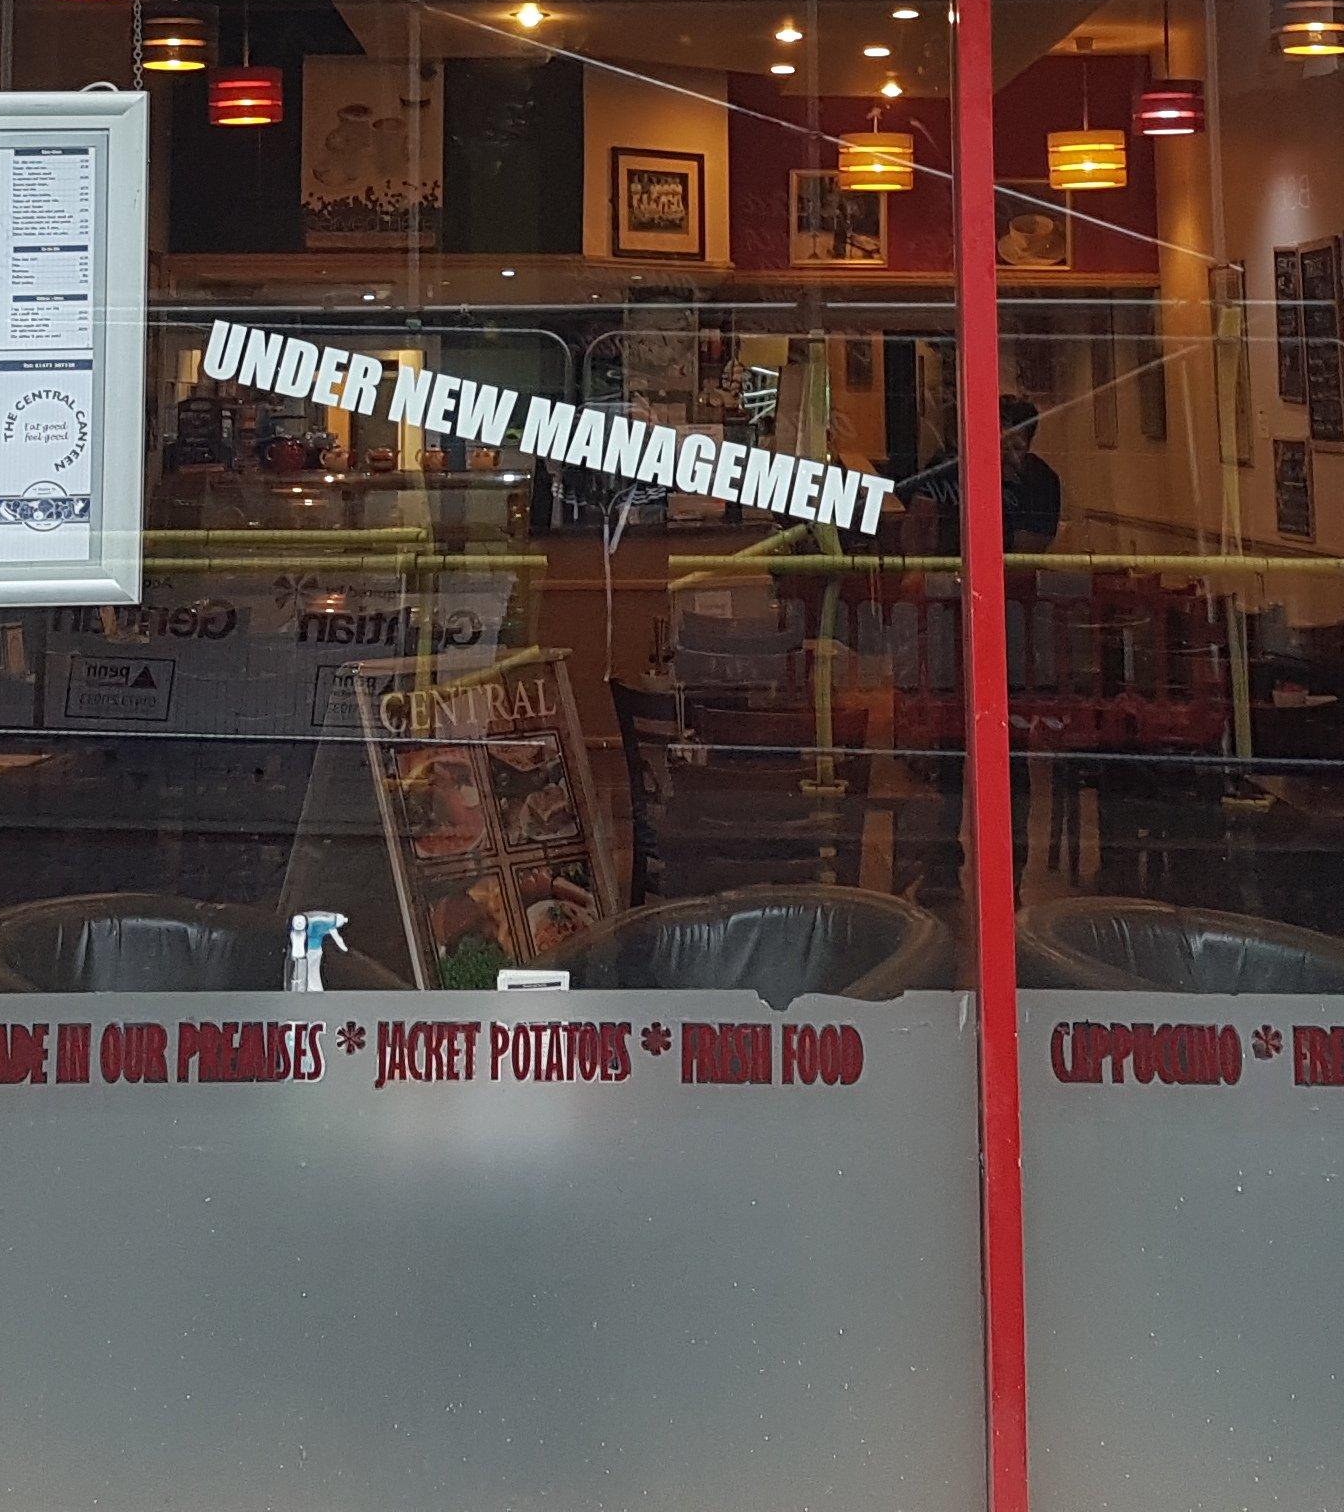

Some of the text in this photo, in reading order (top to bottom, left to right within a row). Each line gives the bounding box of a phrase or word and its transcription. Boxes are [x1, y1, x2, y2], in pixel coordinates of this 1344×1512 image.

[3, 389, 88, 472] THE CENTRAL CANTEEN
[203, 319, 896, 536] UNDER NEW MANAGEMENT
[381, 678, 558, 734] CENTRAL
[56, 1022, 91, 1084] IN
[99, 1021, 169, 1084] OUR
[177, 1021, 326, 1084] PREMISES
[374, 1021, 481, 1089] JACKET
[490, 1021, 633, 1084] POTATOES
[681, 1022, 773, 1085] FRESH
[781, 1022, 864, 1085] FOOD
[1050, 1021, 1243, 1086] CAPPUCCINO
